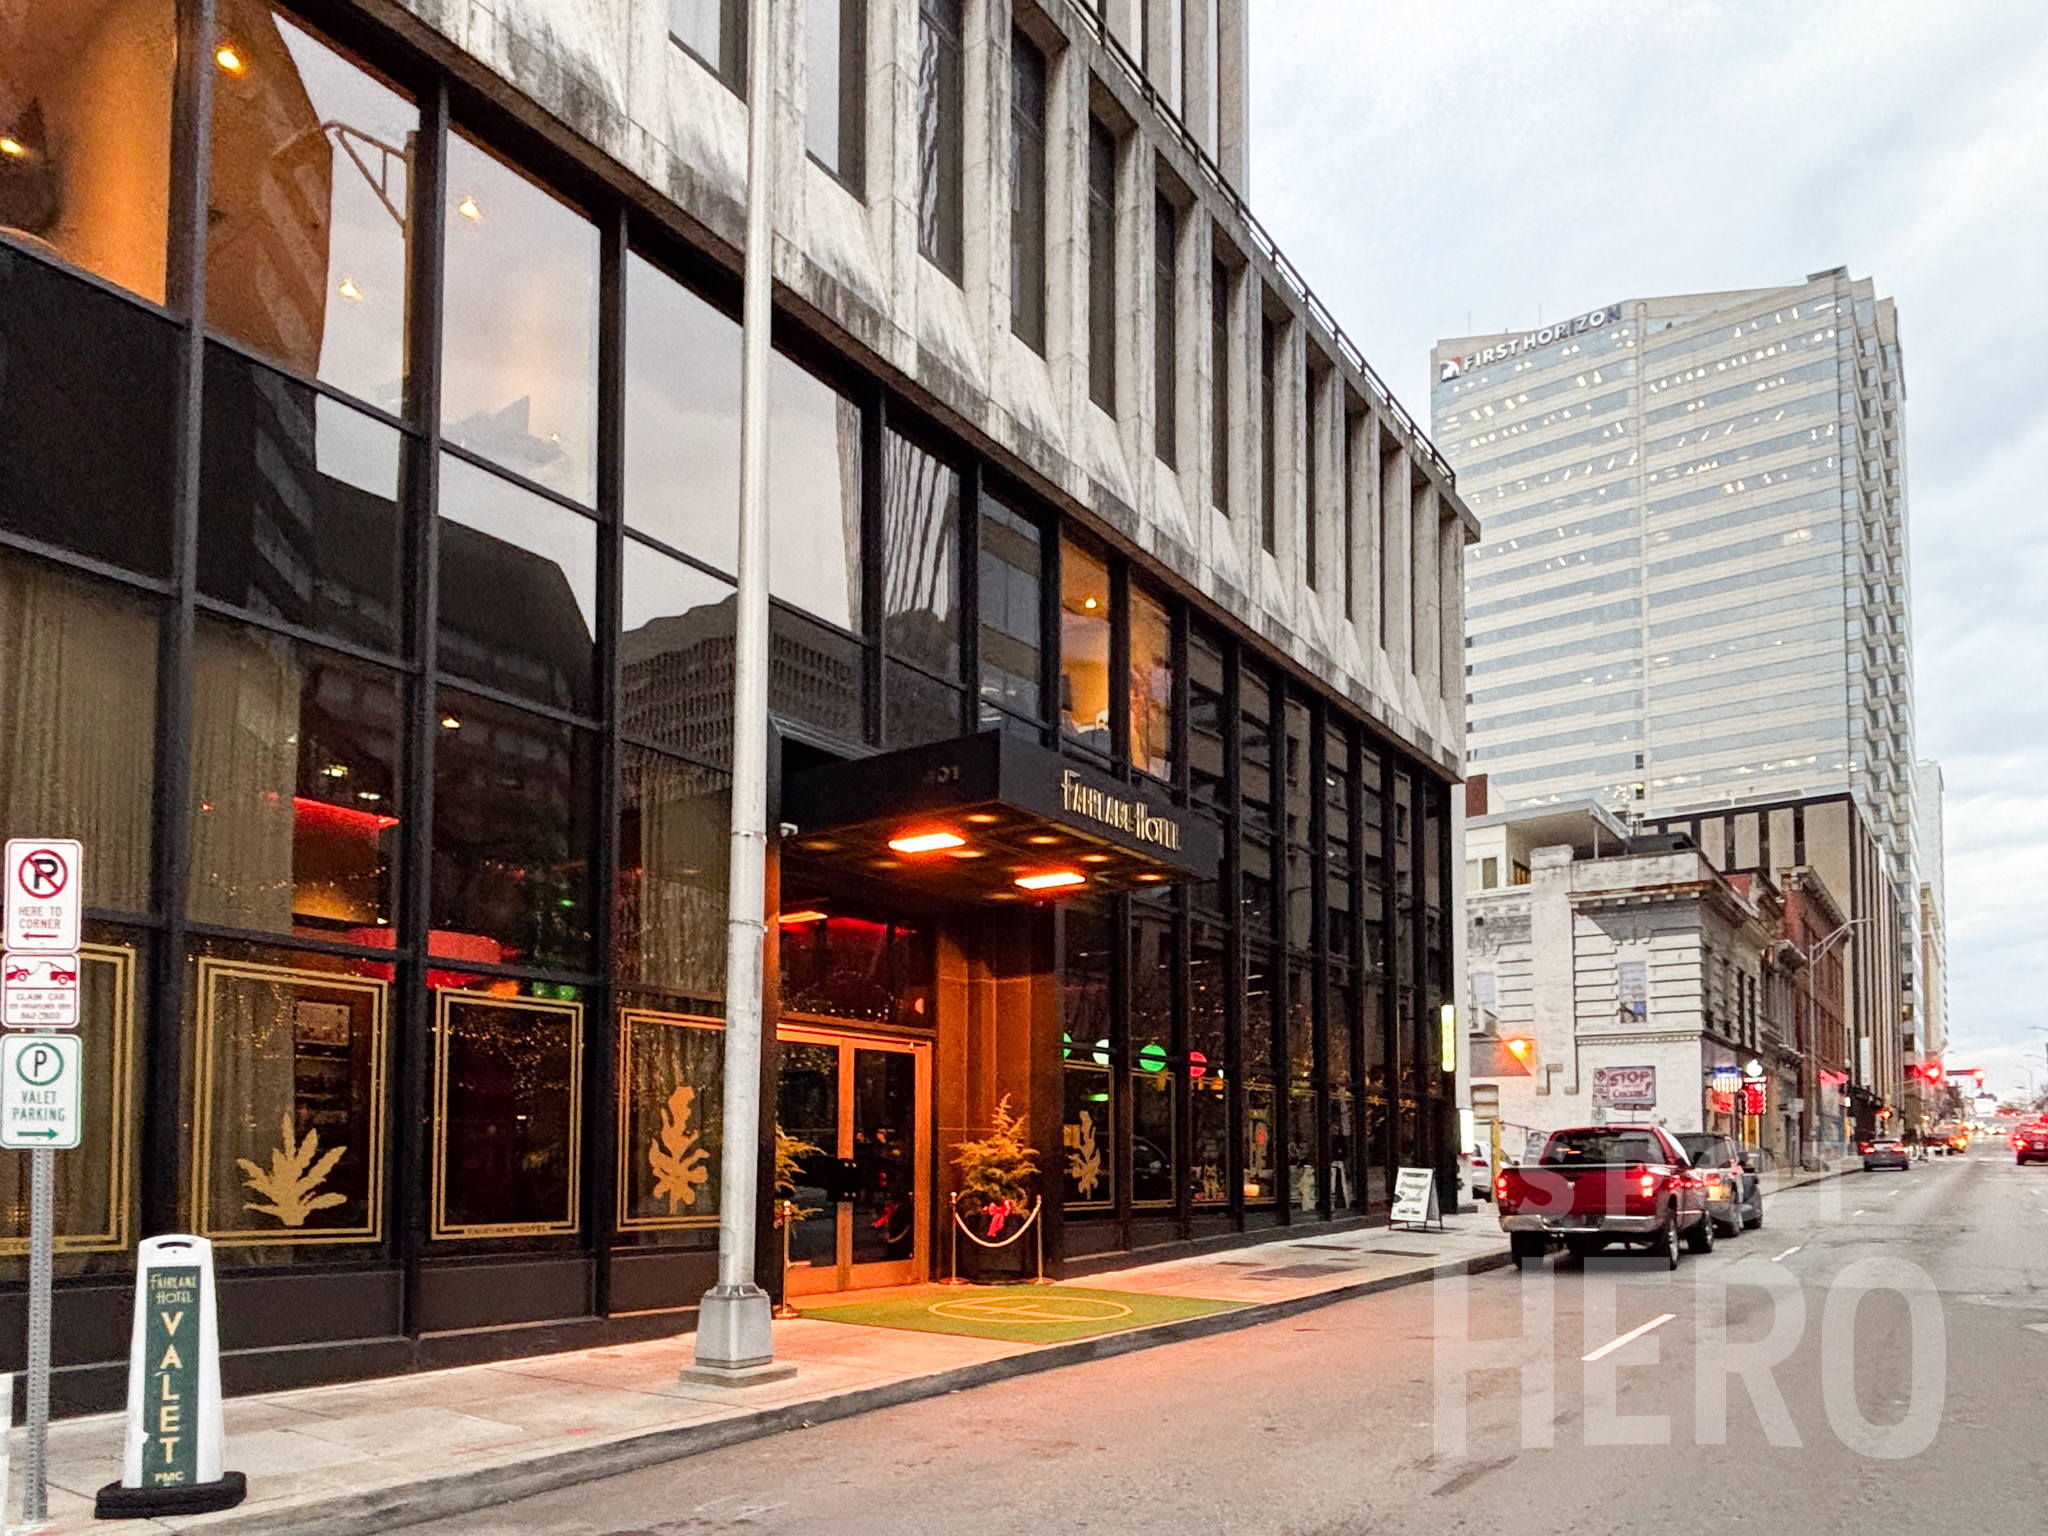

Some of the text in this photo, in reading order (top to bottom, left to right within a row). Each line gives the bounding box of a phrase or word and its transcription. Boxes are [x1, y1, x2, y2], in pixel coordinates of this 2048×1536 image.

[1463, 304, 1622, 372] FIRST HORIZON
[1061, 769, 1181, 850] FAIRLANE HOTEL
[19, 906, 62, 917] HERE TO
[20, 918, 61, 929] CORNER
[16, 993, 65, 1001] CLAIM CAR
[1610, 1071, 1650, 1086] STOP
[21, 1090, 57, 1104] VALET
[12, 1107, 66, 1122] PARKING
[155, 1290, 193, 1305] HOTEL
[158, 1311, 184, 1464] VALET
[154, 1471, 185, 1483] PMC
